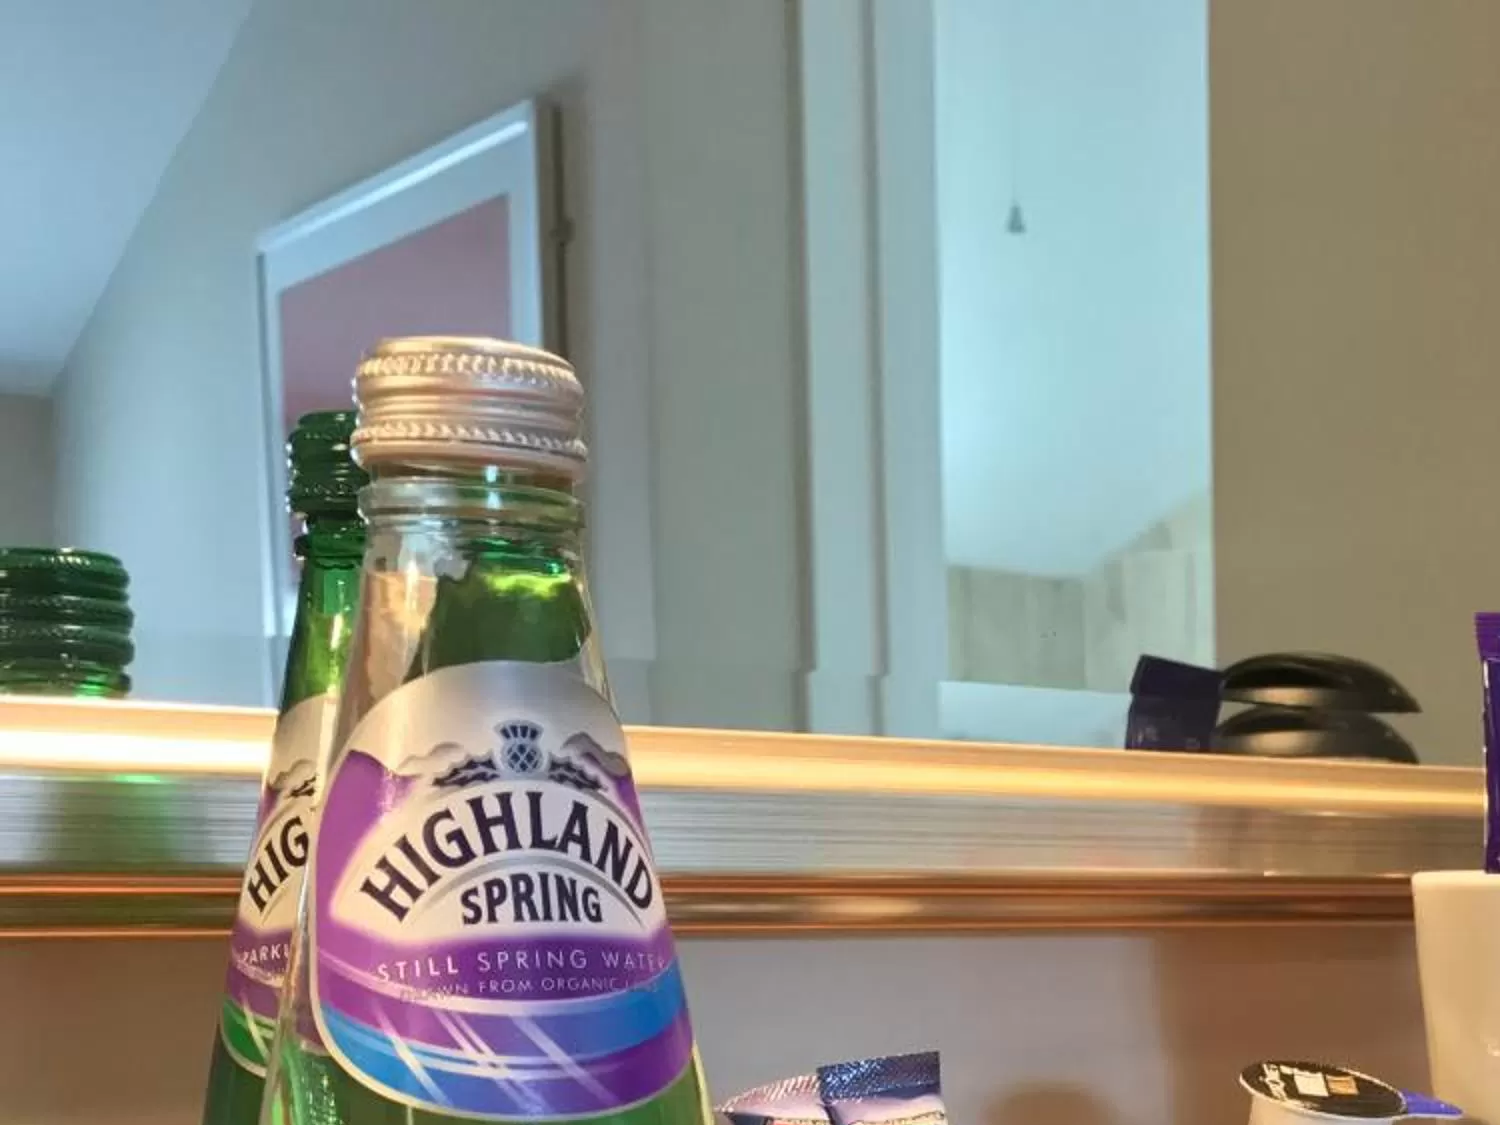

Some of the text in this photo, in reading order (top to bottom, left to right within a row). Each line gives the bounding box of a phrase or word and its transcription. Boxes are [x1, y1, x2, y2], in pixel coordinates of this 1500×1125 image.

[359, 791, 653, 922] HIGHLAND
[461, 872, 604, 926] SPRING
[377, 955, 460, 982] STILL
[477, 949, 588, 973] SPRING
[479, 979, 534, 995] FROM
[541, 976, 624, 993] ORGANIC
